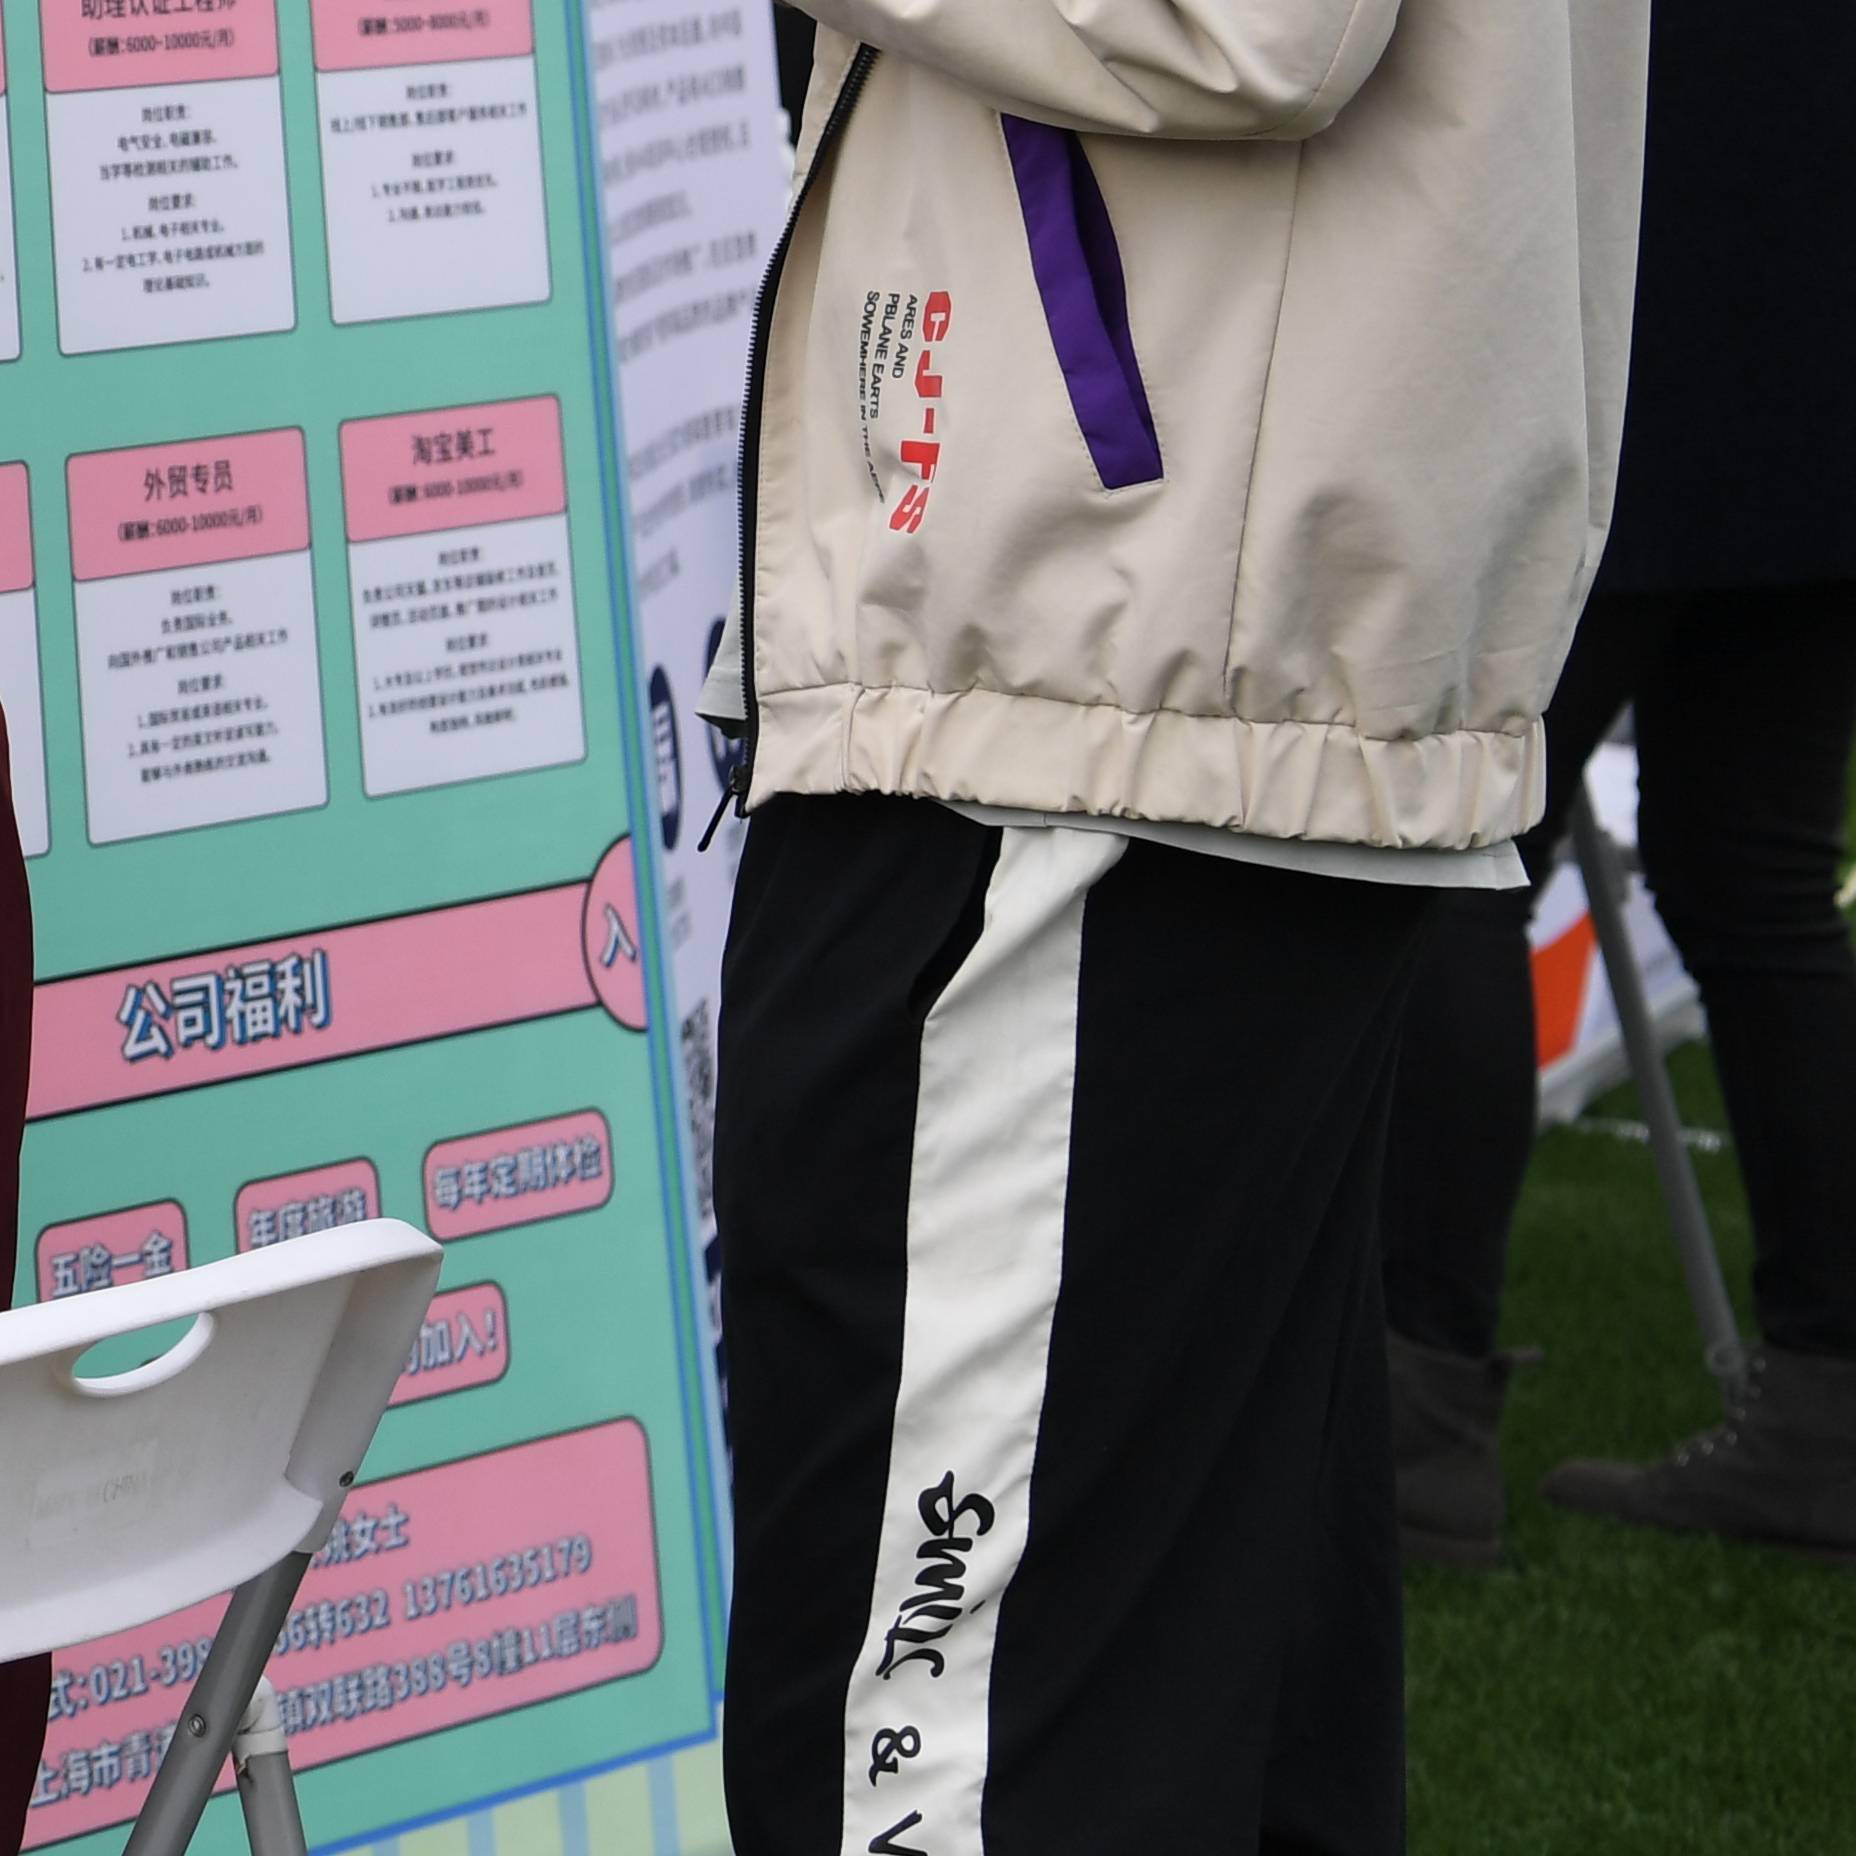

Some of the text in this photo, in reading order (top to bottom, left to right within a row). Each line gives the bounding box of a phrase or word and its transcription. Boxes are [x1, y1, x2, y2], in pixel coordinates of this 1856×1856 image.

[892, 294, 918, 379] ARES AND
[869, 364, 884, 420] EARTS
[144, 460, 234, 502] 外贸专员
[411, 428, 496, 467] 淘宝美工
[600, 903, 641, 968] 入
[117, 949, 334, 1064] 公司福利
[433, 1136, 603, 1213] 每年定期体检
[52, 1230, 174, 1303] 五险一金
[403, 1534, 592, 1621] 13761635179
[869, 1725, 922, 1787] &
